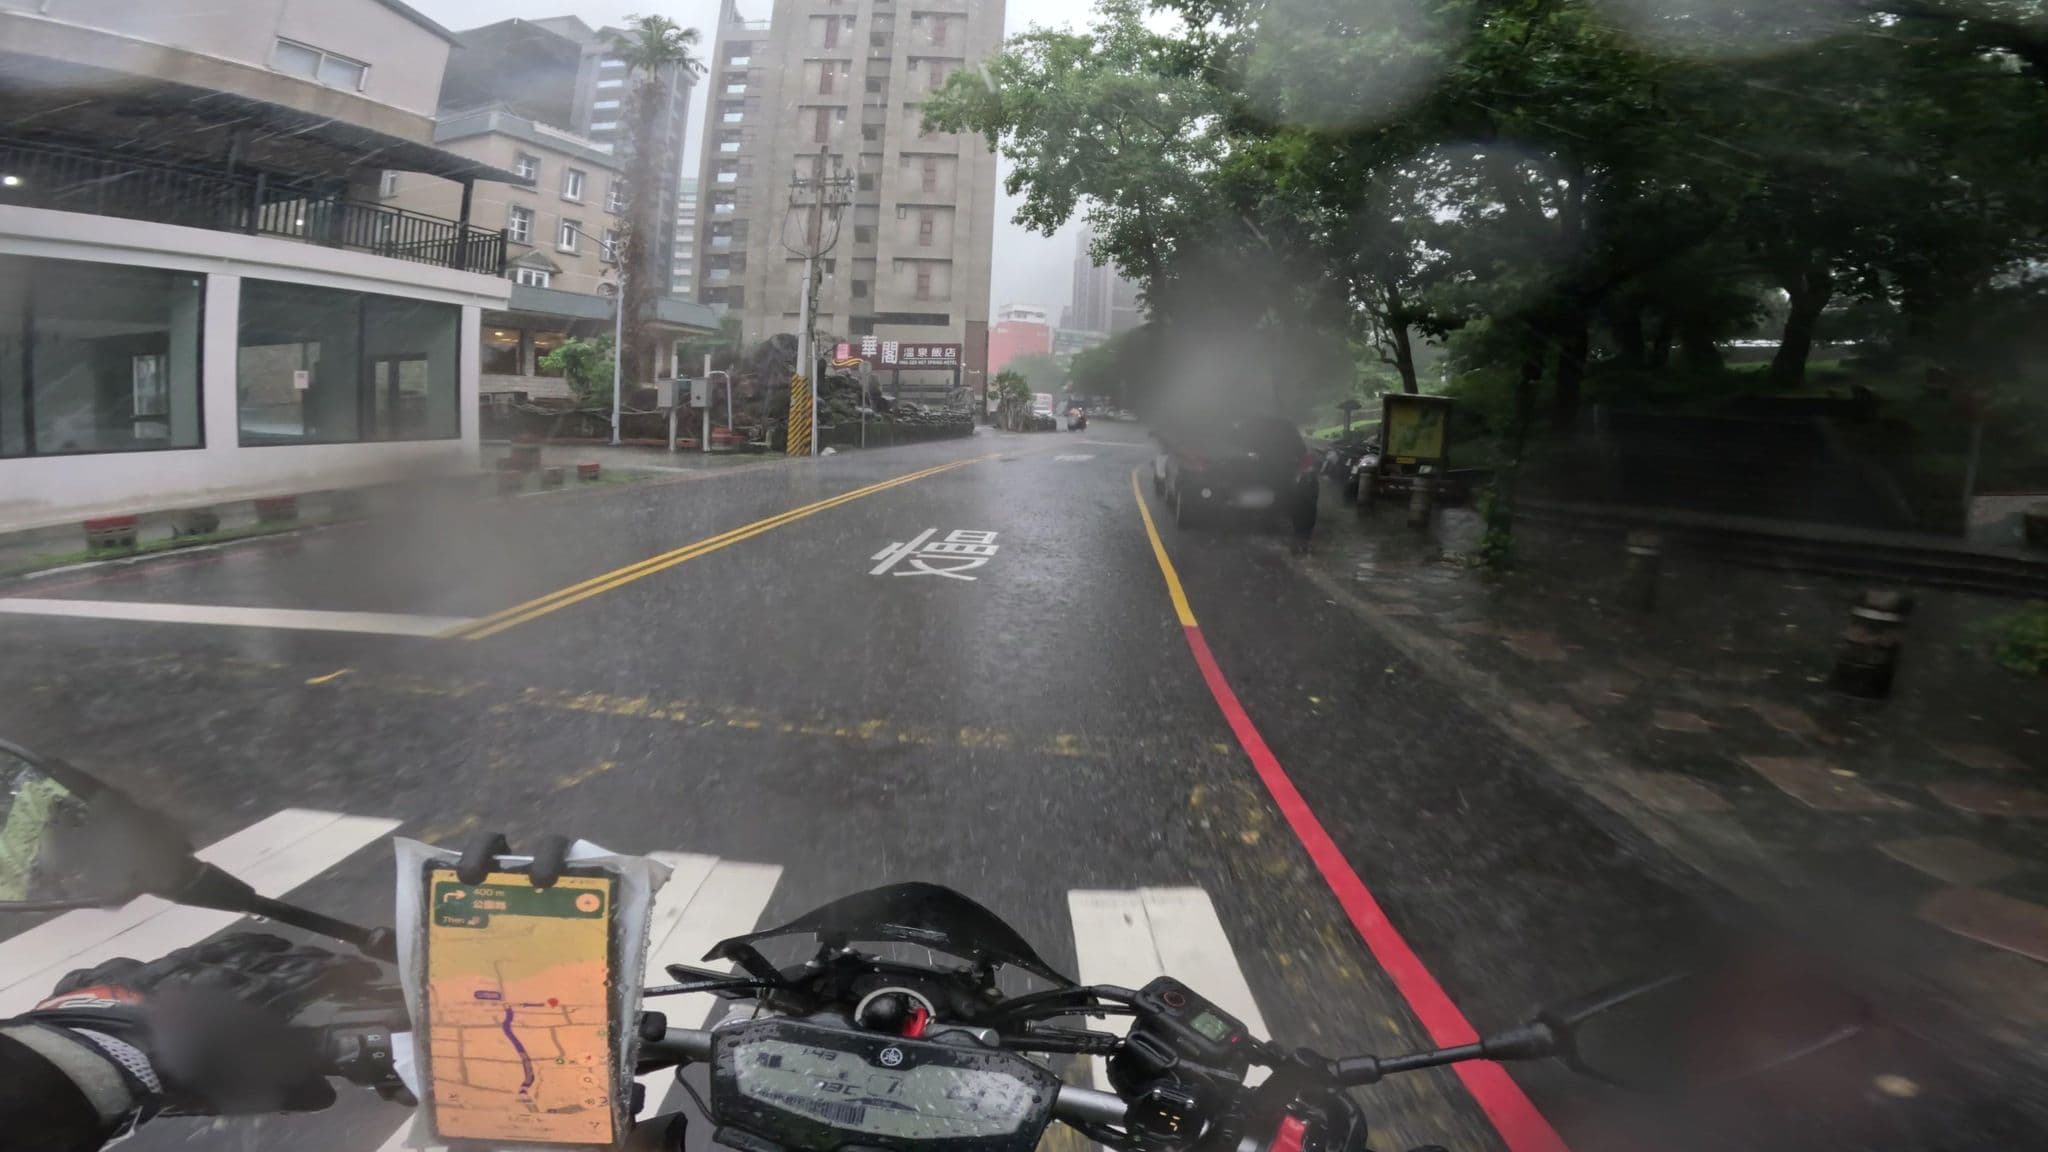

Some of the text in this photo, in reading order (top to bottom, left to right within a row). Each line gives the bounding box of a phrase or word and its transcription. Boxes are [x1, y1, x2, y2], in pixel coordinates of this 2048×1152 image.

[861, 335, 898, 363] 華閣
[903, 347, 956, 358] 溫泉飯店
[868, 528, 999, 582] 慢
